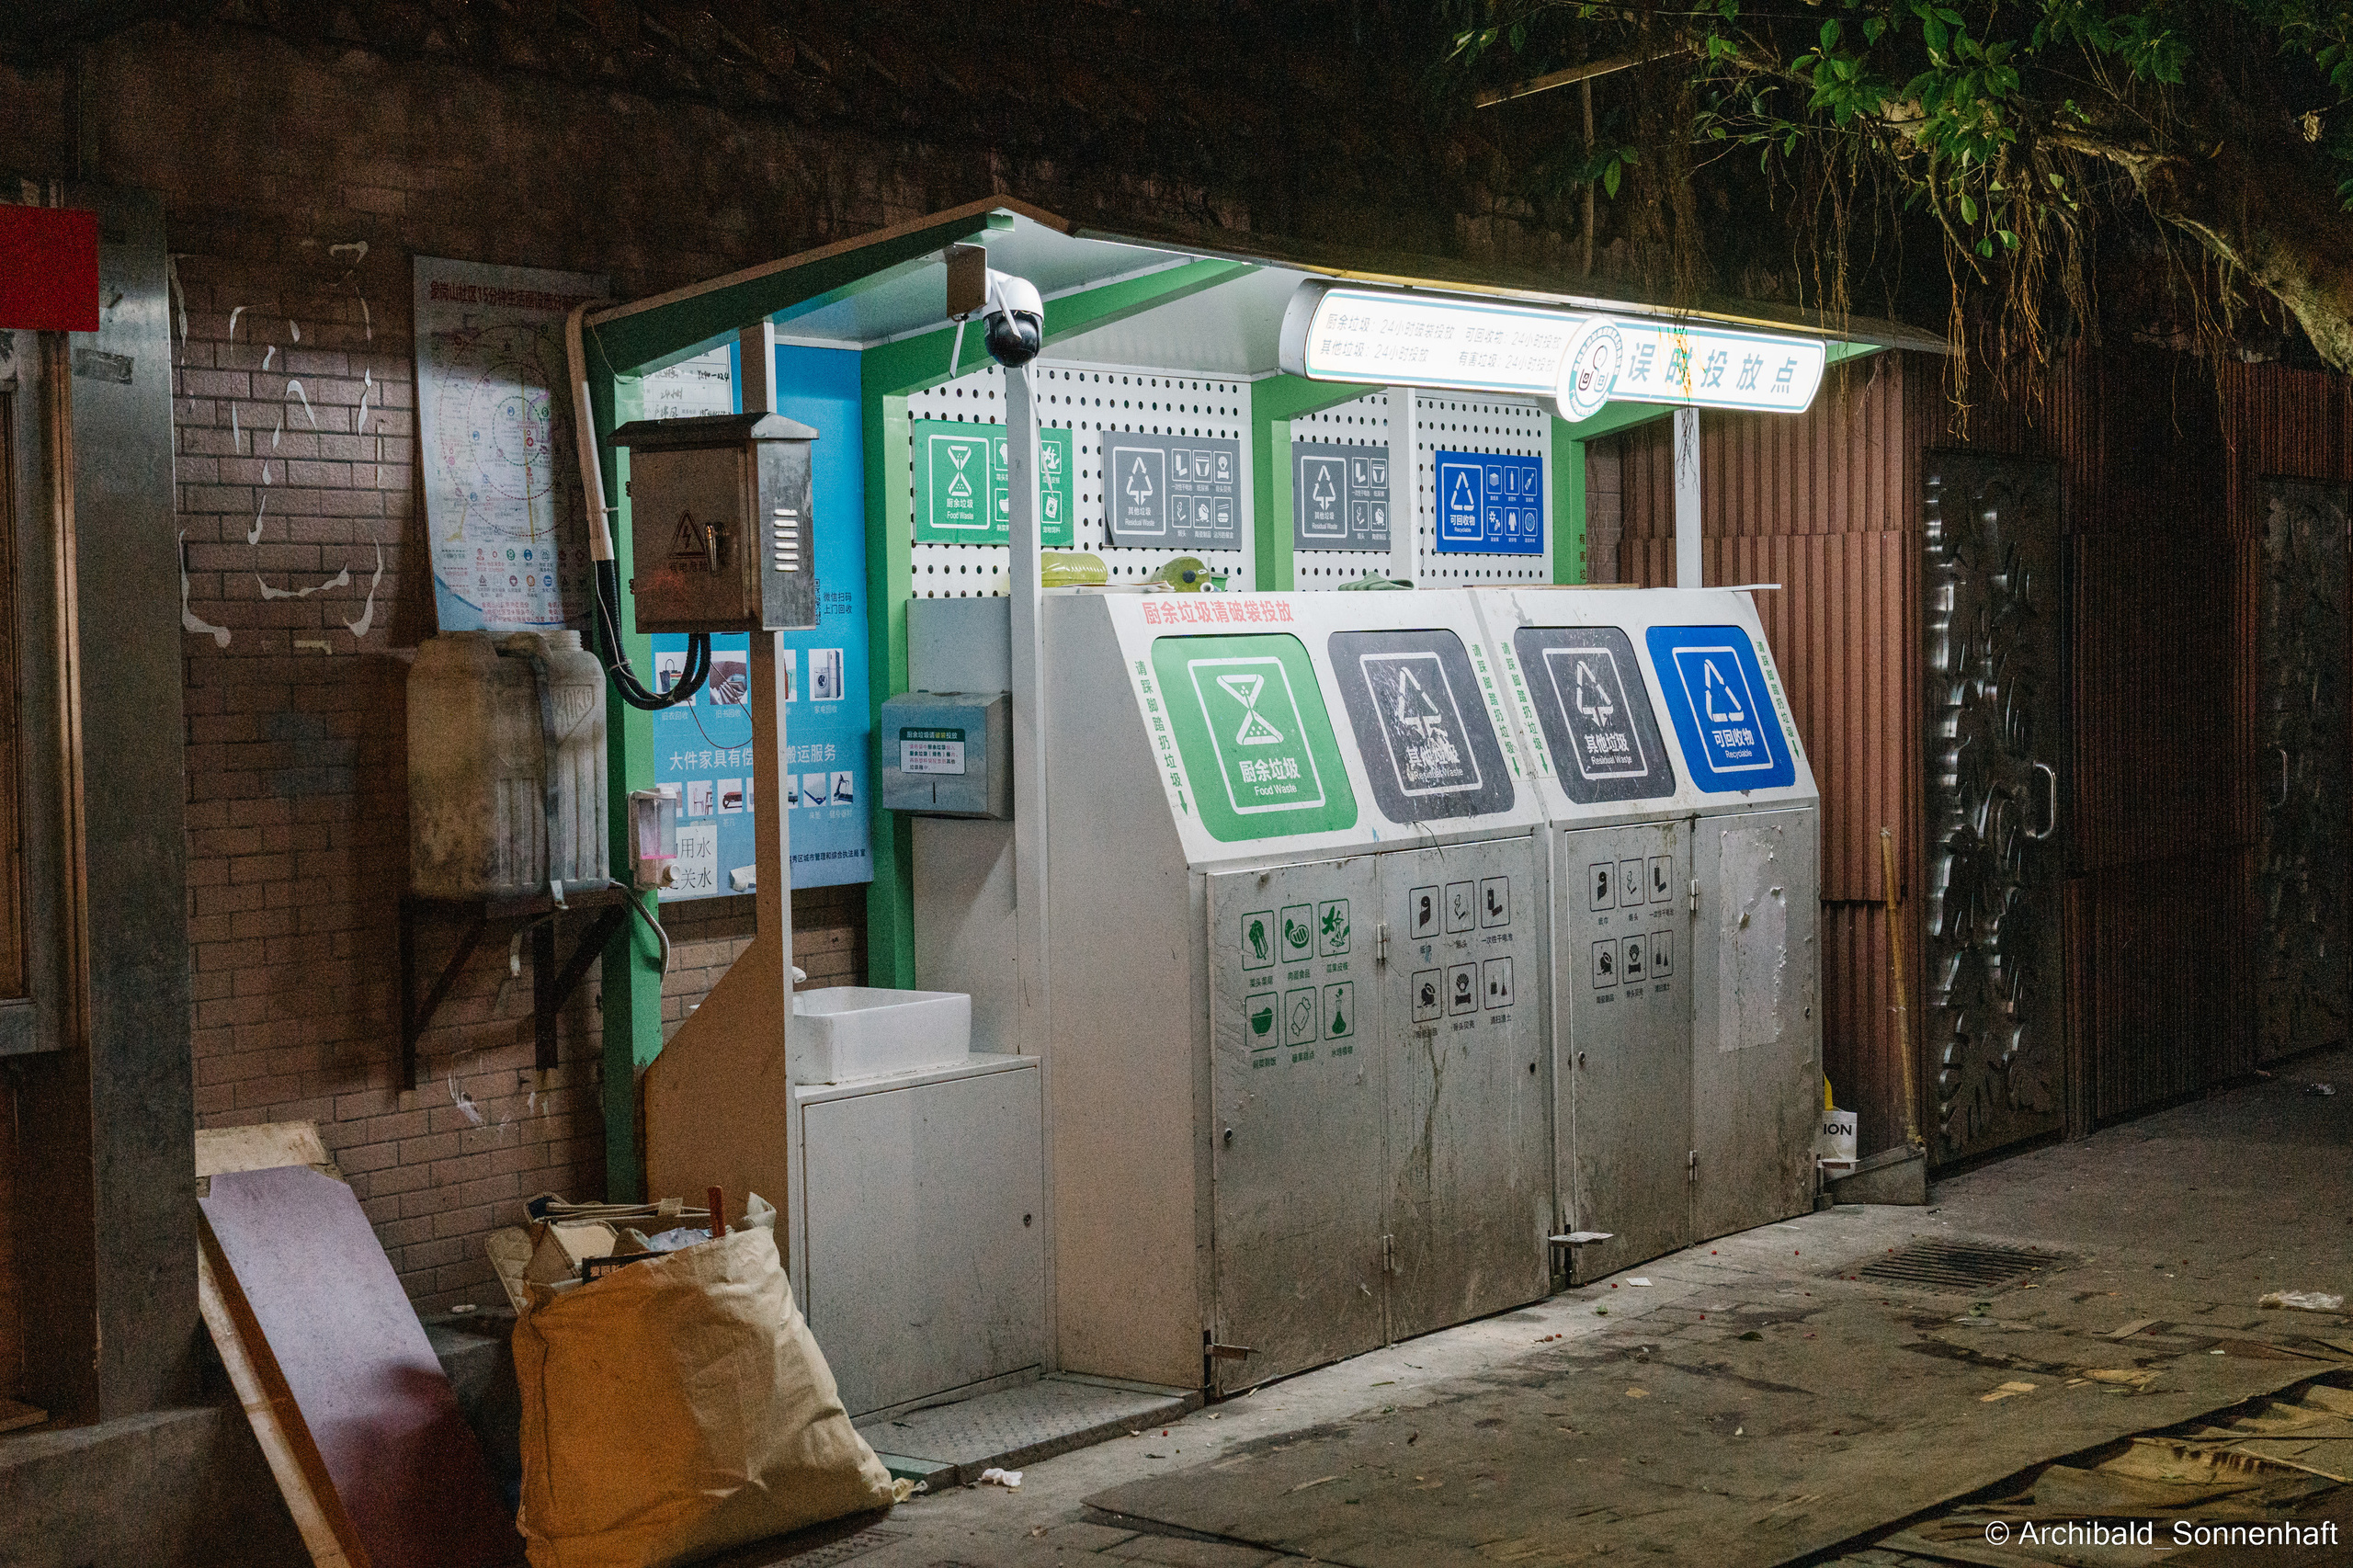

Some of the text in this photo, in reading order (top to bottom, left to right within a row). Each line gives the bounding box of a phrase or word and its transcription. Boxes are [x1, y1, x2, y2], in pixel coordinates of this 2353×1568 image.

[1628, 343, 1798, 393] 误时投放点
[947, 498, 973, 508] 厨余垃圾
[947, 511, 974, 520] Food Waste
[1128, 506, 1152, 516] 其他垃圾
[1314, 511, 1336, 520] 其他垃圾
[1125, 517, 1142, 526] Residual
[1449, 515, 1476, 527] 可回收物
[824, 592, 852, 602] 微信扫码
[824, 604, 853, 615] 上门回收
[1142, 600, 1294, 625] 厨余垃圾请破袋投放
[1756, 641, 1794, 738] 请踩脚踏扔垃圾
[1471, 643, 1515, 754] 请踩脚踏扔垃圾
[1500, 642, 1543, 750] 请踩脚踏扔垃圾
[715, 709, 742, 719] 旧书回收
[813, 704, 838, 715] 家电回收
[1134, 660, 1183, 788] 请踩脚踏扔垃圾
[906, 731, 958, 740] 厨余垃圾请破袋投放
[1711, 728, 1755, 748] 可回收物
[1584, 732, 1630, 755] 其他垃圾
[1725, 749, 1753, 759] Recyclable
[1591, 755, 1633, 766] Residual Waste
[1239, 756, 1302, 783] 厨余垃圾
[1254, 783, 1298, 796] Food Waste
[676, 837, 711, 859] 用水
[1481, 933, 1514, 945] 一次性干电池
